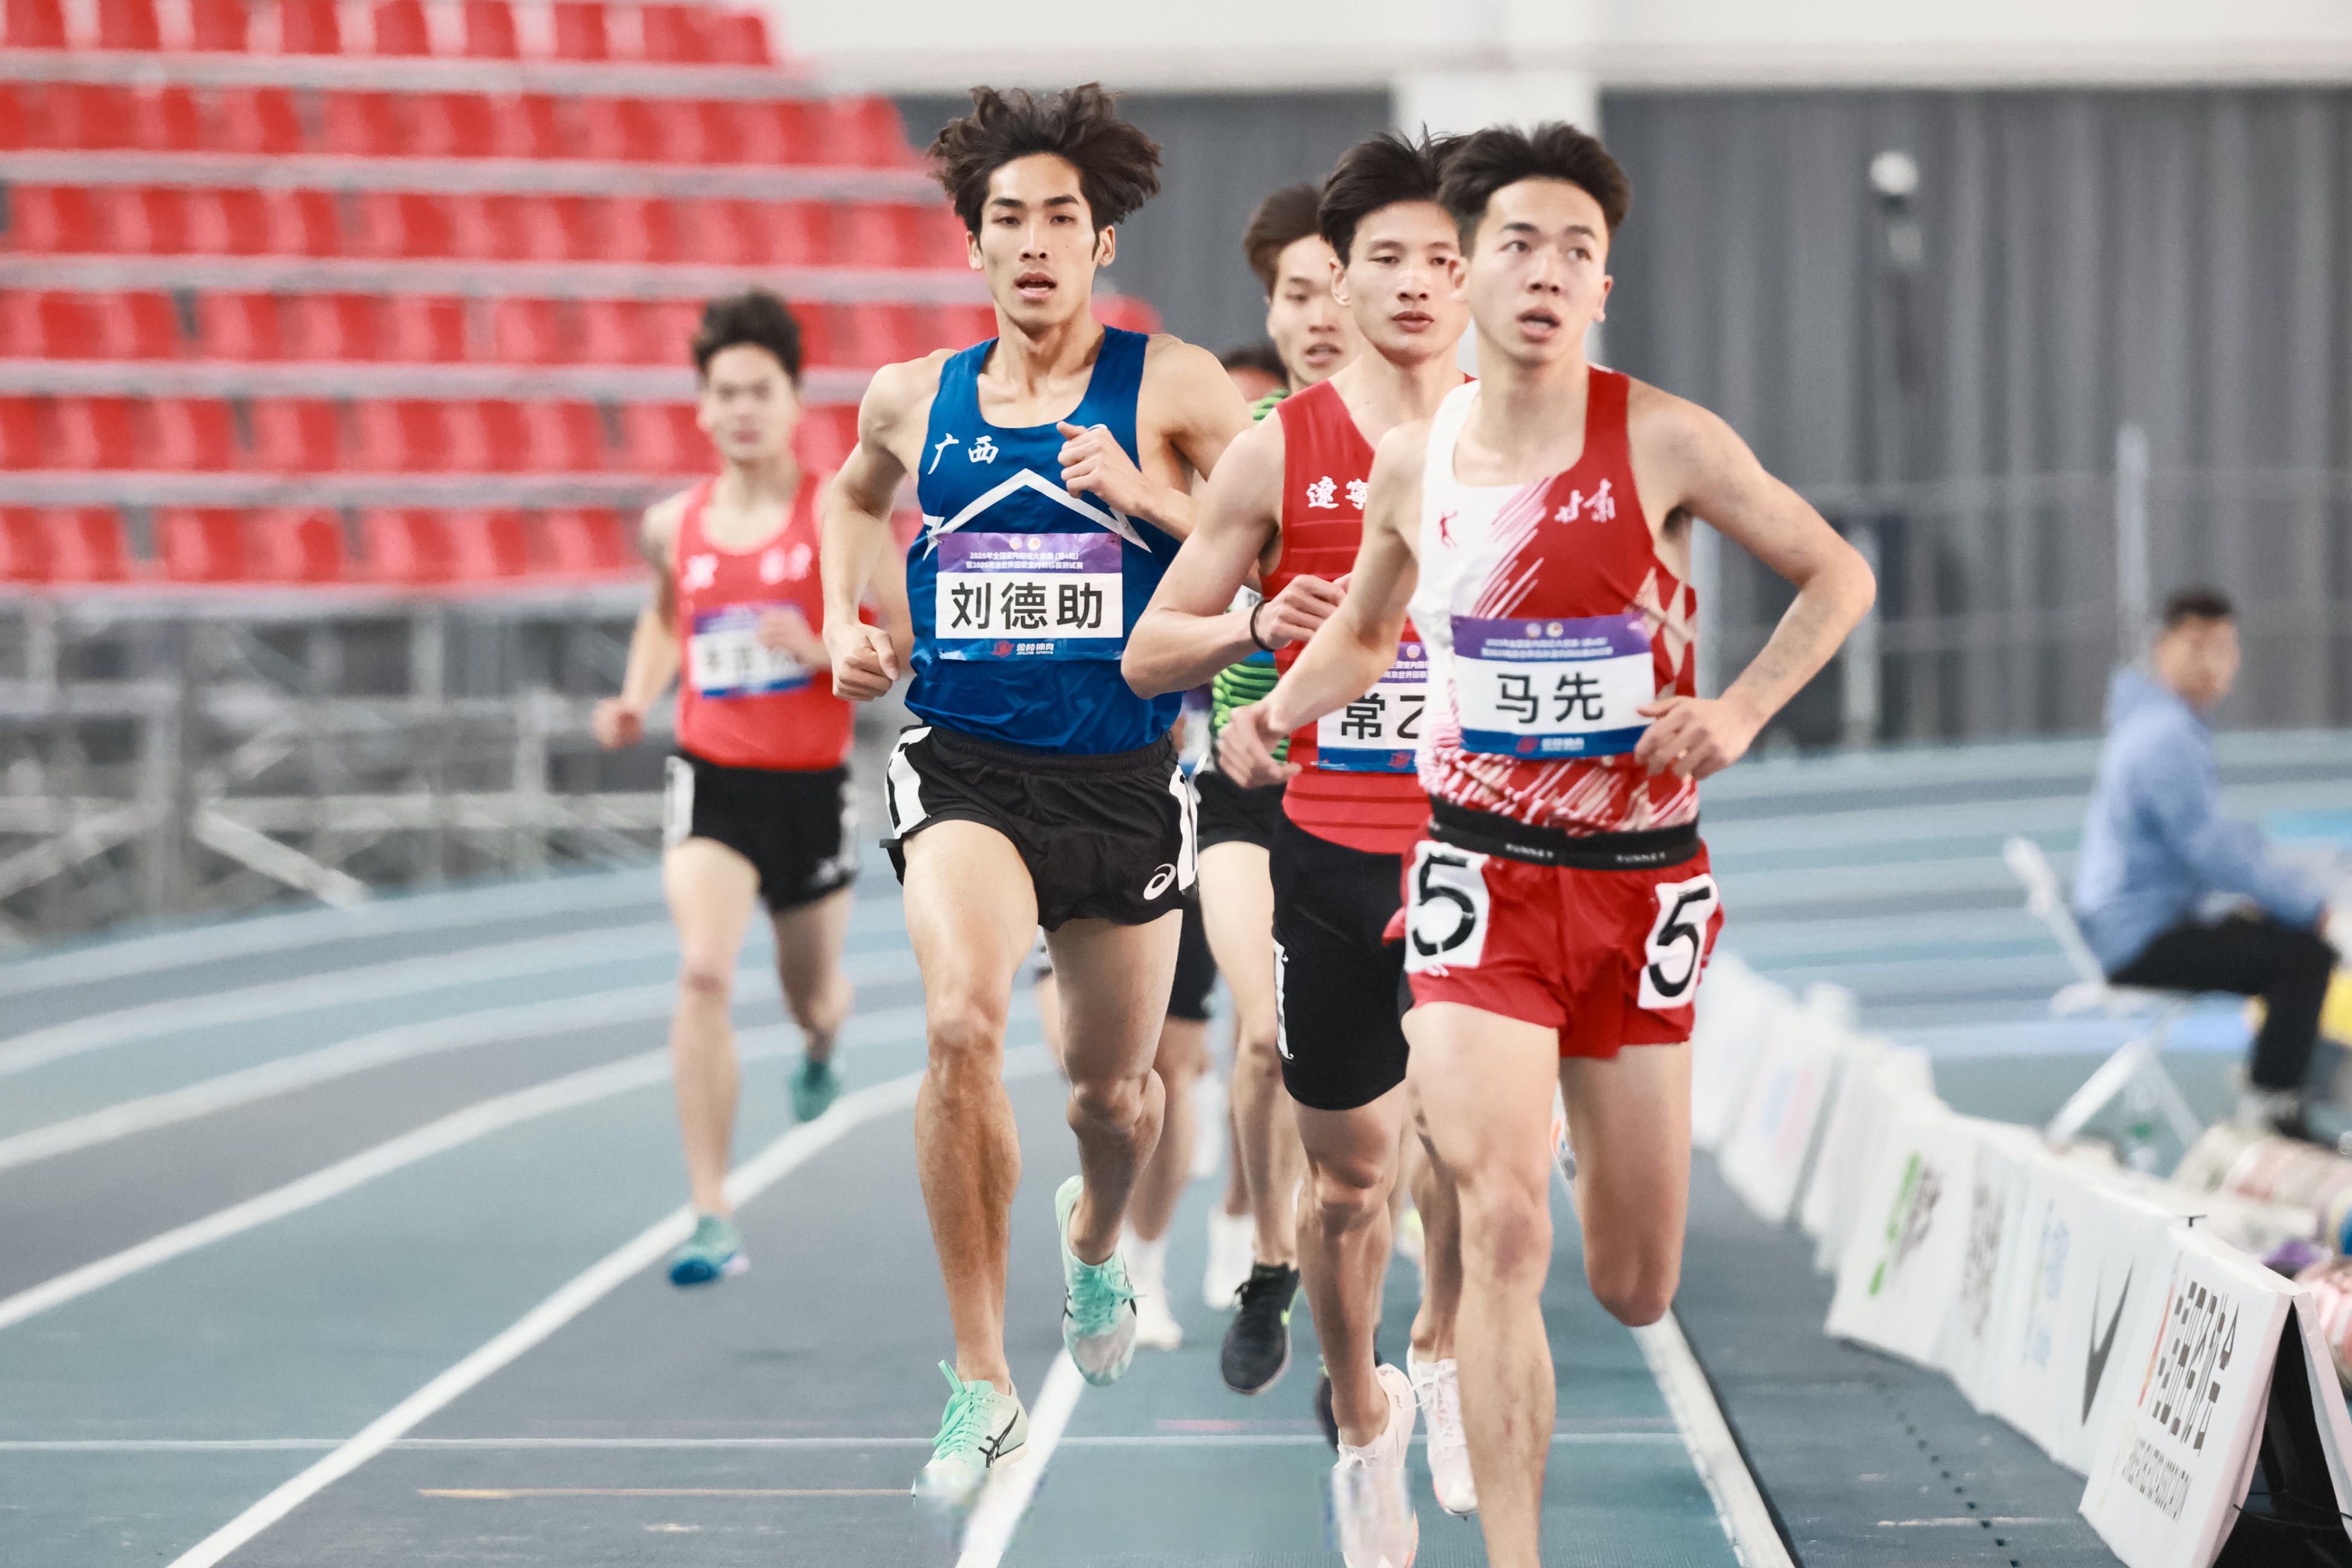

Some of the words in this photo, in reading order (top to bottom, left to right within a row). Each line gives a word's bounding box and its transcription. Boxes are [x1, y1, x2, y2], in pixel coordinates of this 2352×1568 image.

[927, 433, 999, 475] 广西
[950, 582, 1103, 630] 刘德助
[1496, 671, 1604, 724] 马先
[1413, 853, 1477, 956] 5
[1649, 887, 1710, 997] 5
